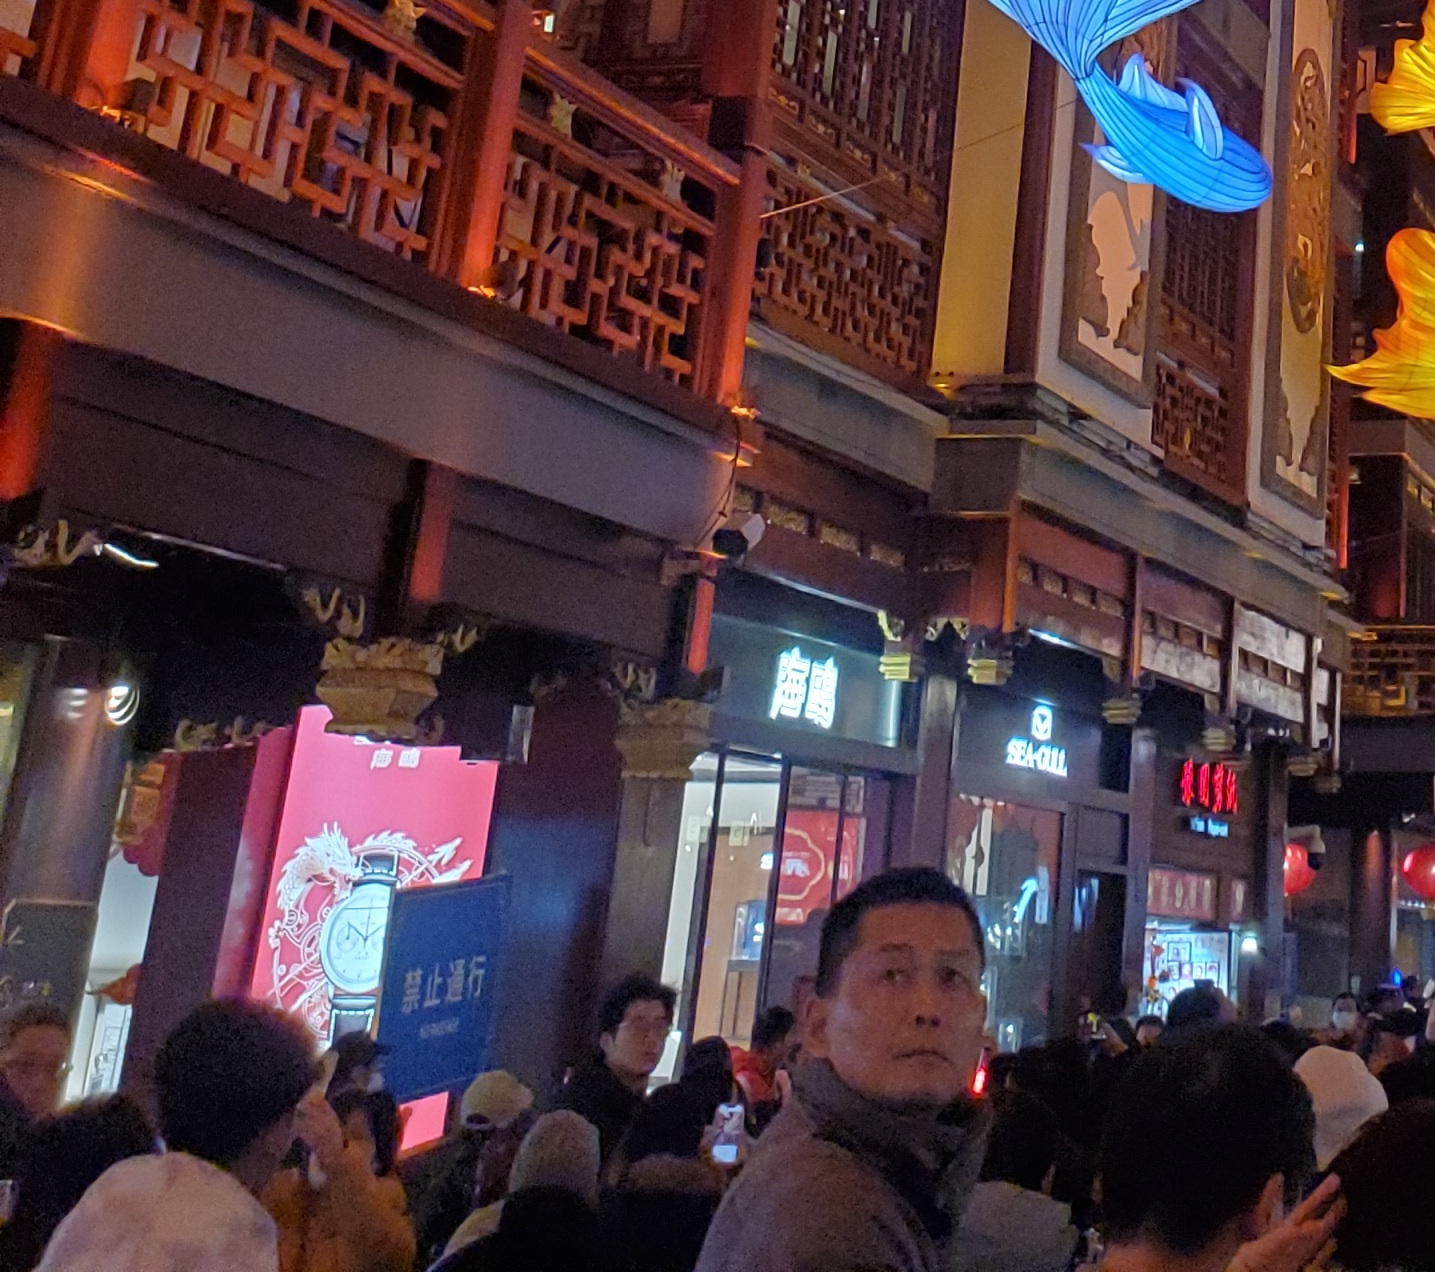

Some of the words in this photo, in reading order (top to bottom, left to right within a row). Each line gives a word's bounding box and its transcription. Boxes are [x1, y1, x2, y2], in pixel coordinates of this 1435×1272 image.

[769, 645, 839, 729] 海鸥
[401, 955, 486, 1013] 禁止通行
